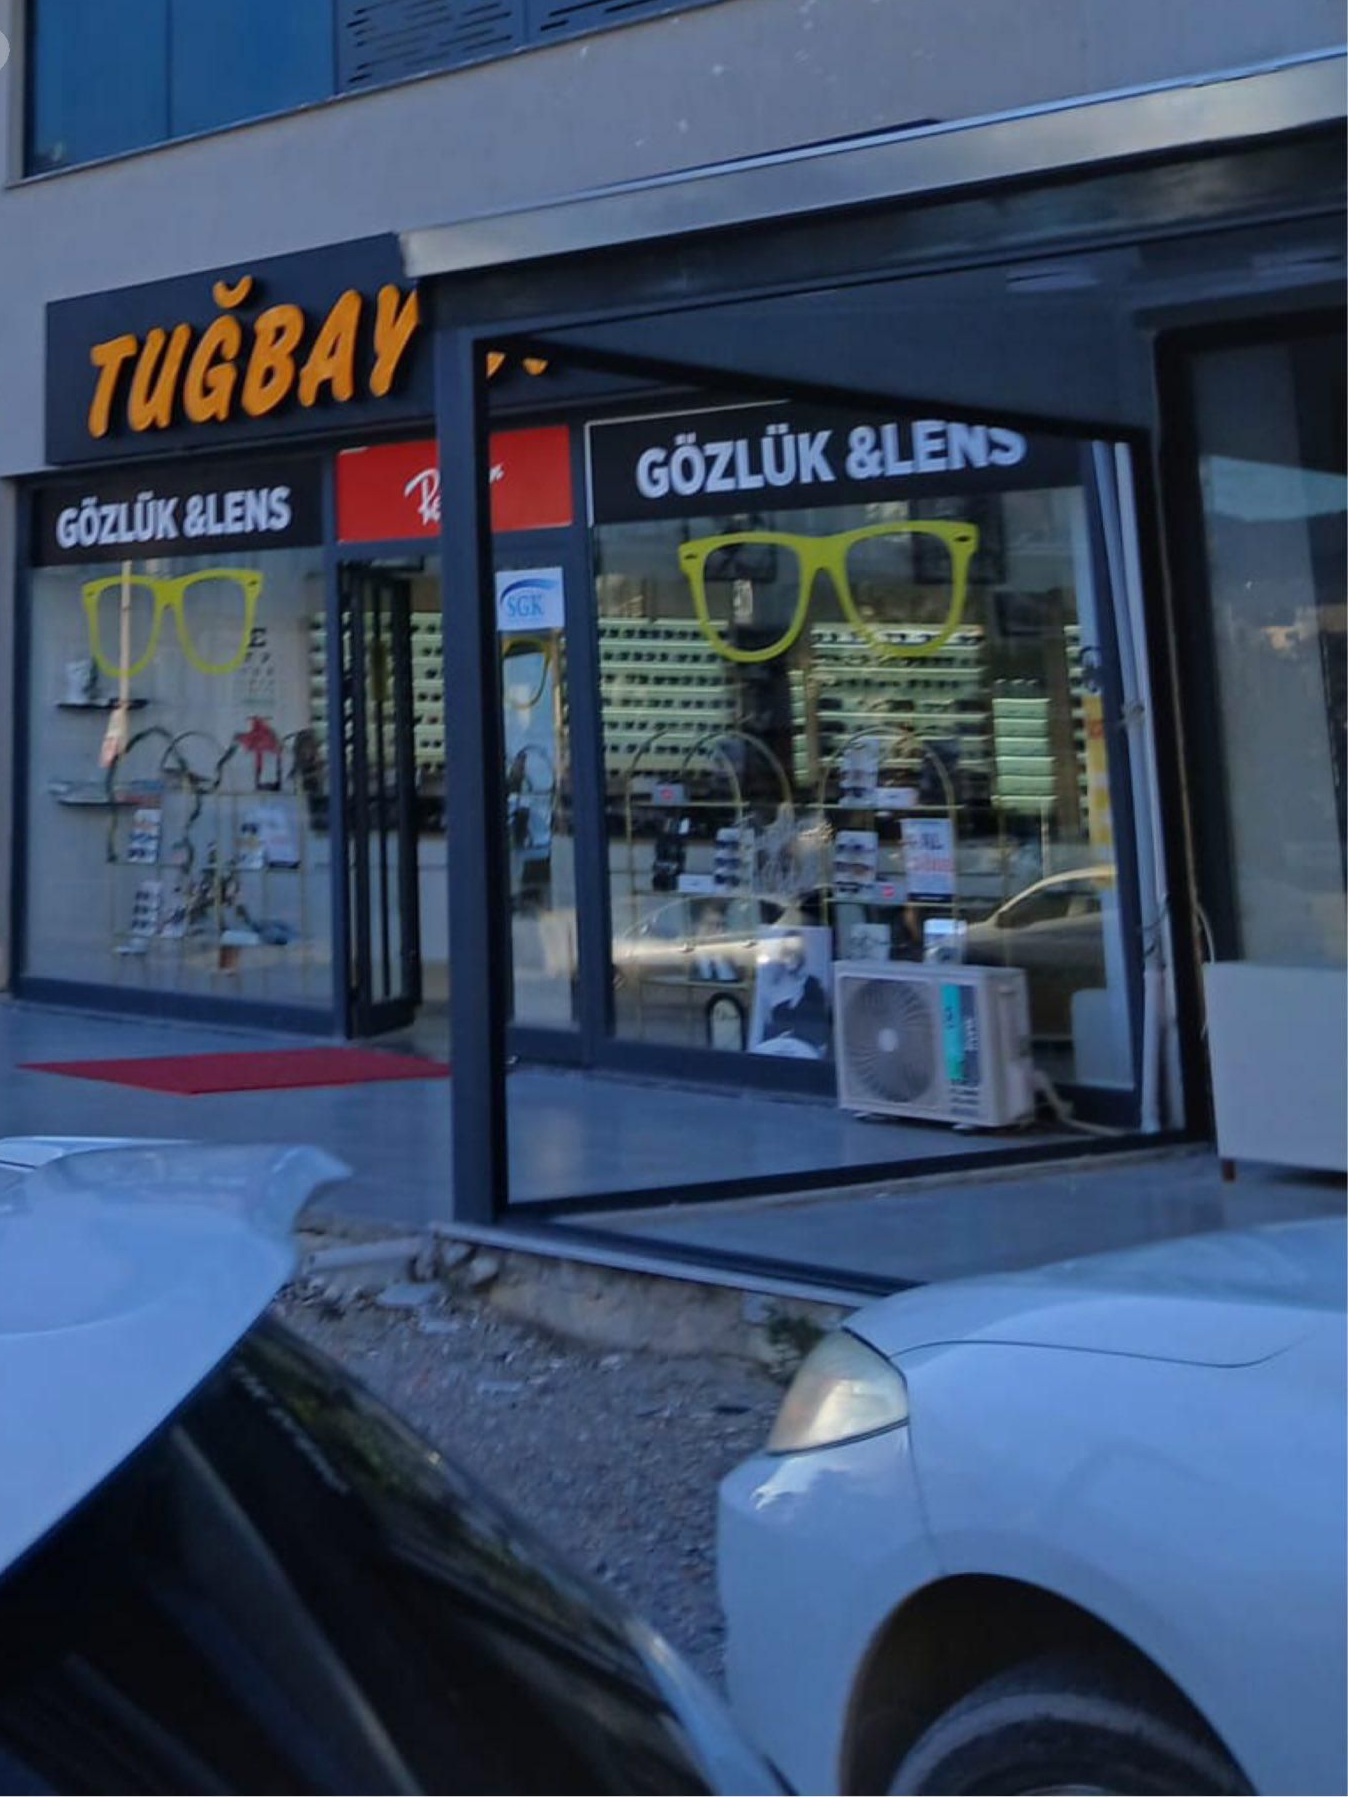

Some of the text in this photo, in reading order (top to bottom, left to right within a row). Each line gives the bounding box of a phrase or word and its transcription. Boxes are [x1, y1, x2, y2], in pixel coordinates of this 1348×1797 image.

[87, 276, 419, 438] TUĞBAY
[636, 419, 1028, 499] GÖZLÜK &LENS
[56, 486, 292, 549] GÖZLÜK &LENS
[506, 594, 545, 618] SGK
